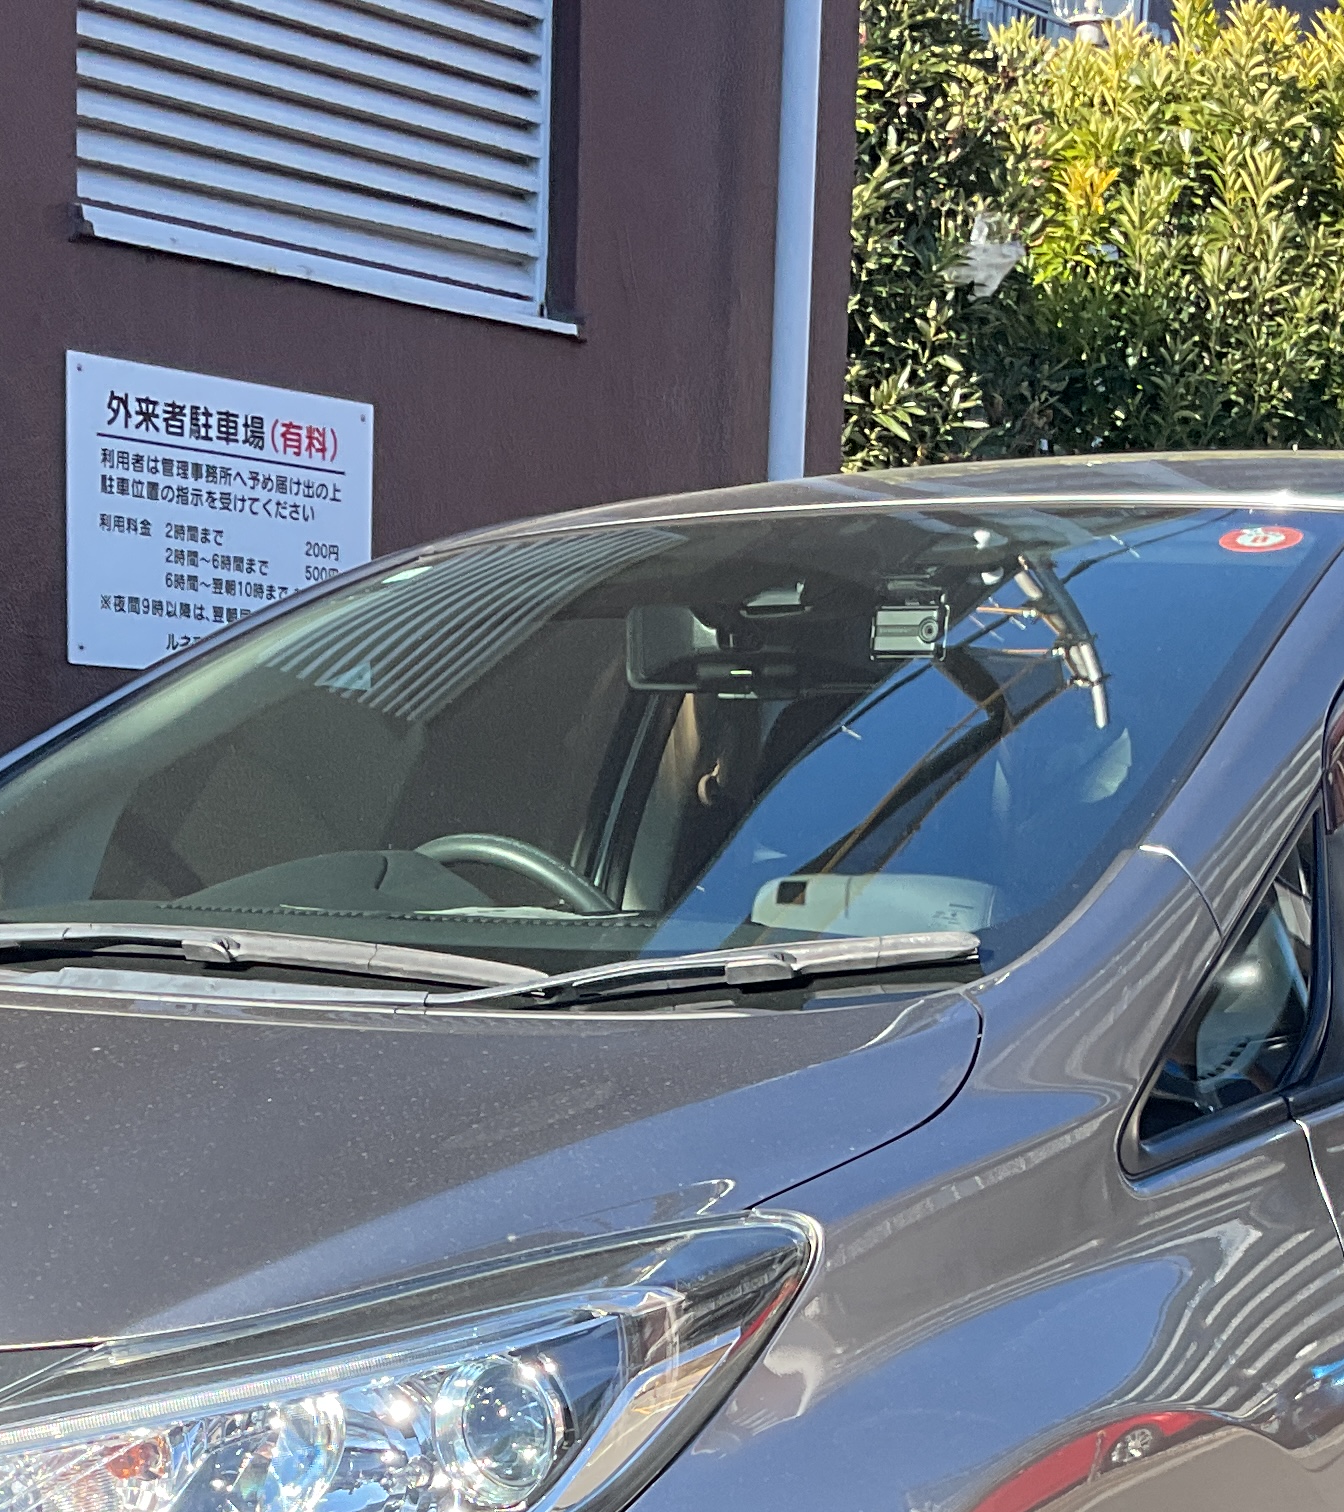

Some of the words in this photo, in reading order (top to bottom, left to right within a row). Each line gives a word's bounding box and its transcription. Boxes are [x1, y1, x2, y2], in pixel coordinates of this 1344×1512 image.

[100, 447, 342, 503] 利用者は管理事務所へ予め届け出の上
[100, 474, 315, 522] 駐車位置の指示を受けてください
[98, 513, 152, 538] 利用料金
[165, 522, 224, 547] 2時間まで
[304, 542, 340, 562] 200円
